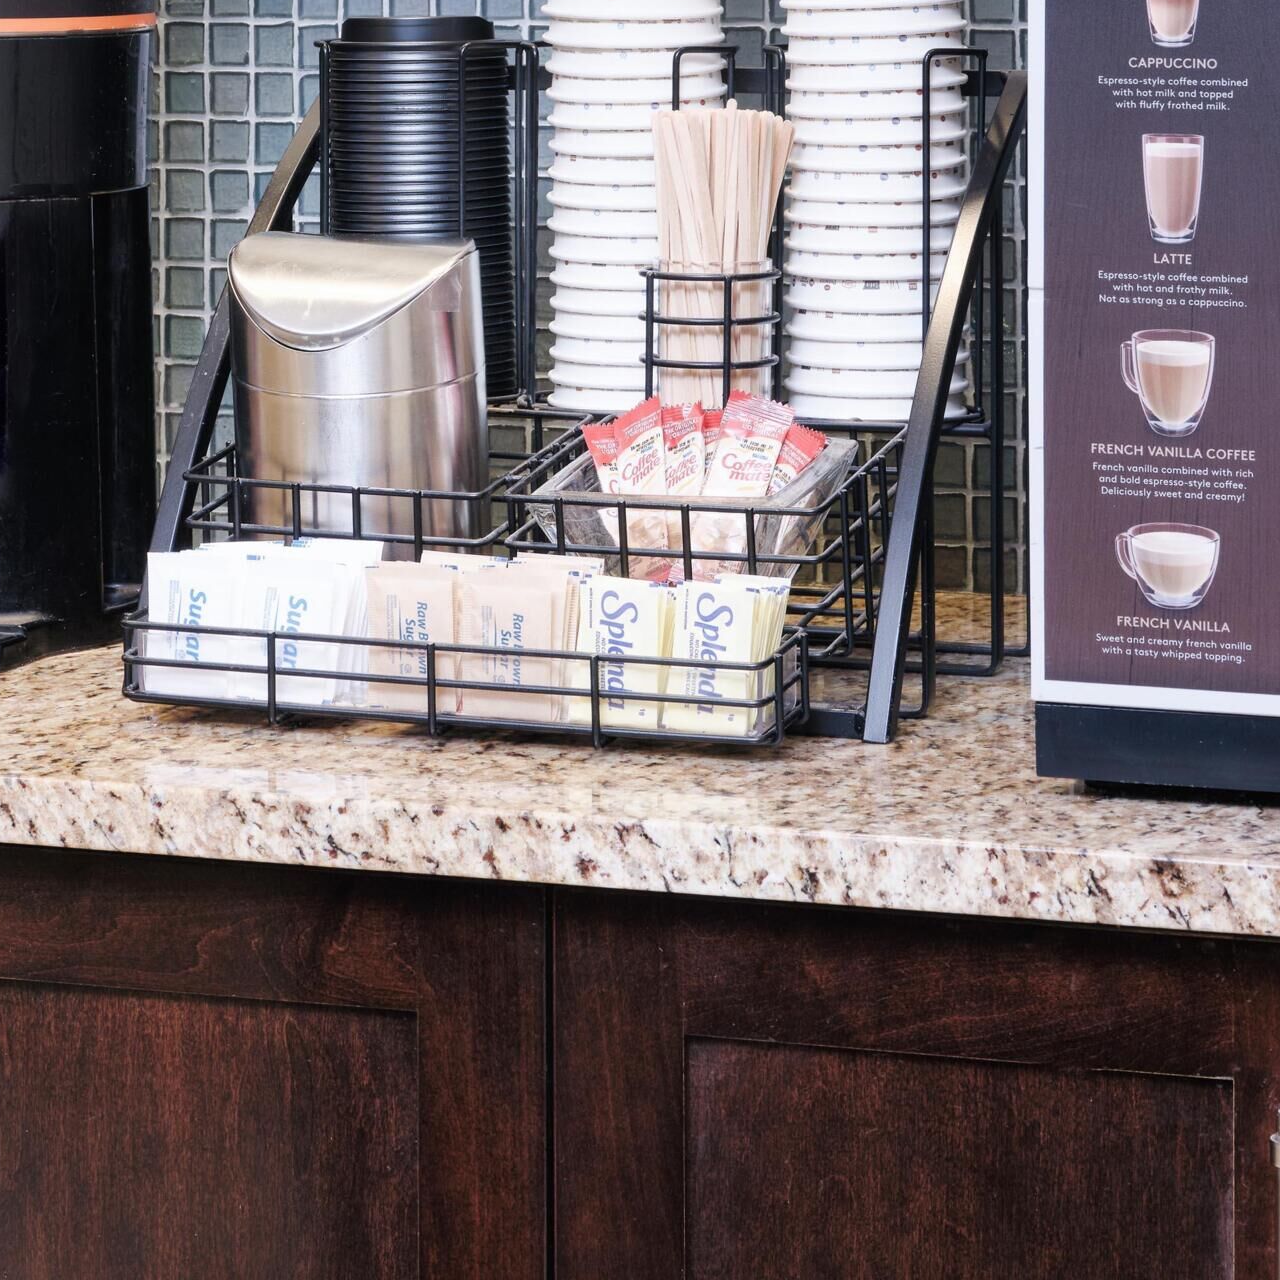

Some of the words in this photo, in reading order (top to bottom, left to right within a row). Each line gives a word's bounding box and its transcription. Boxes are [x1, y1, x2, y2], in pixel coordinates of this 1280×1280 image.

[1128, 57, 1218, 70] CAPPUCCINO
[1153, 253, 1192, 265] LATTE
[1091, 443, 1144, 457] FRENCH
[1147, 446, 1203, 459] VANILLA
[1206, 448, 1256, 461] COFFEE
[722, 453, 771, 471] Coffee
[729, 469, 770, 481] mate
